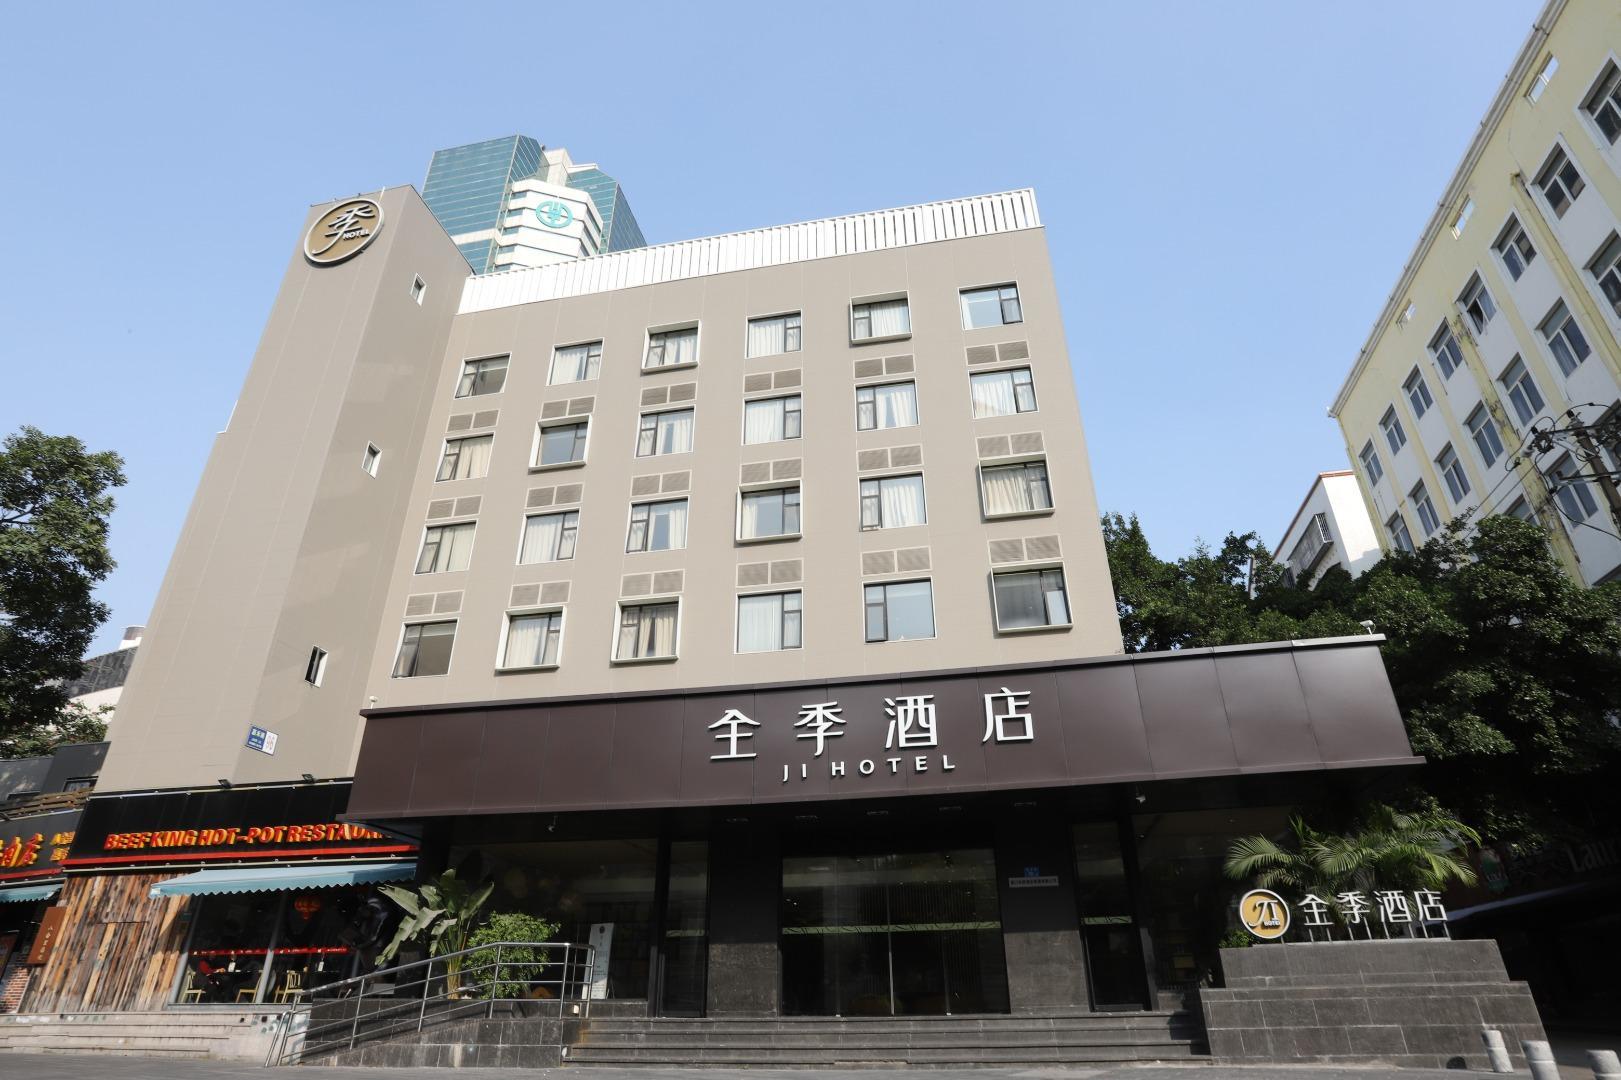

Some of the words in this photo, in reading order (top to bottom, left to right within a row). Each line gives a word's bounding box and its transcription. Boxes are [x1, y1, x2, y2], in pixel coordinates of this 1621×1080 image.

[342, 229, 369, 240] HOTEL
[708, 687, 1034, 760] 全季酒店
[783, 763, 808, 782] JI
[831, 754, 955, 777] HOTEL
[150, 829, 198, 847] KING
[1297, 888, 1449, 927] 全季酒店
